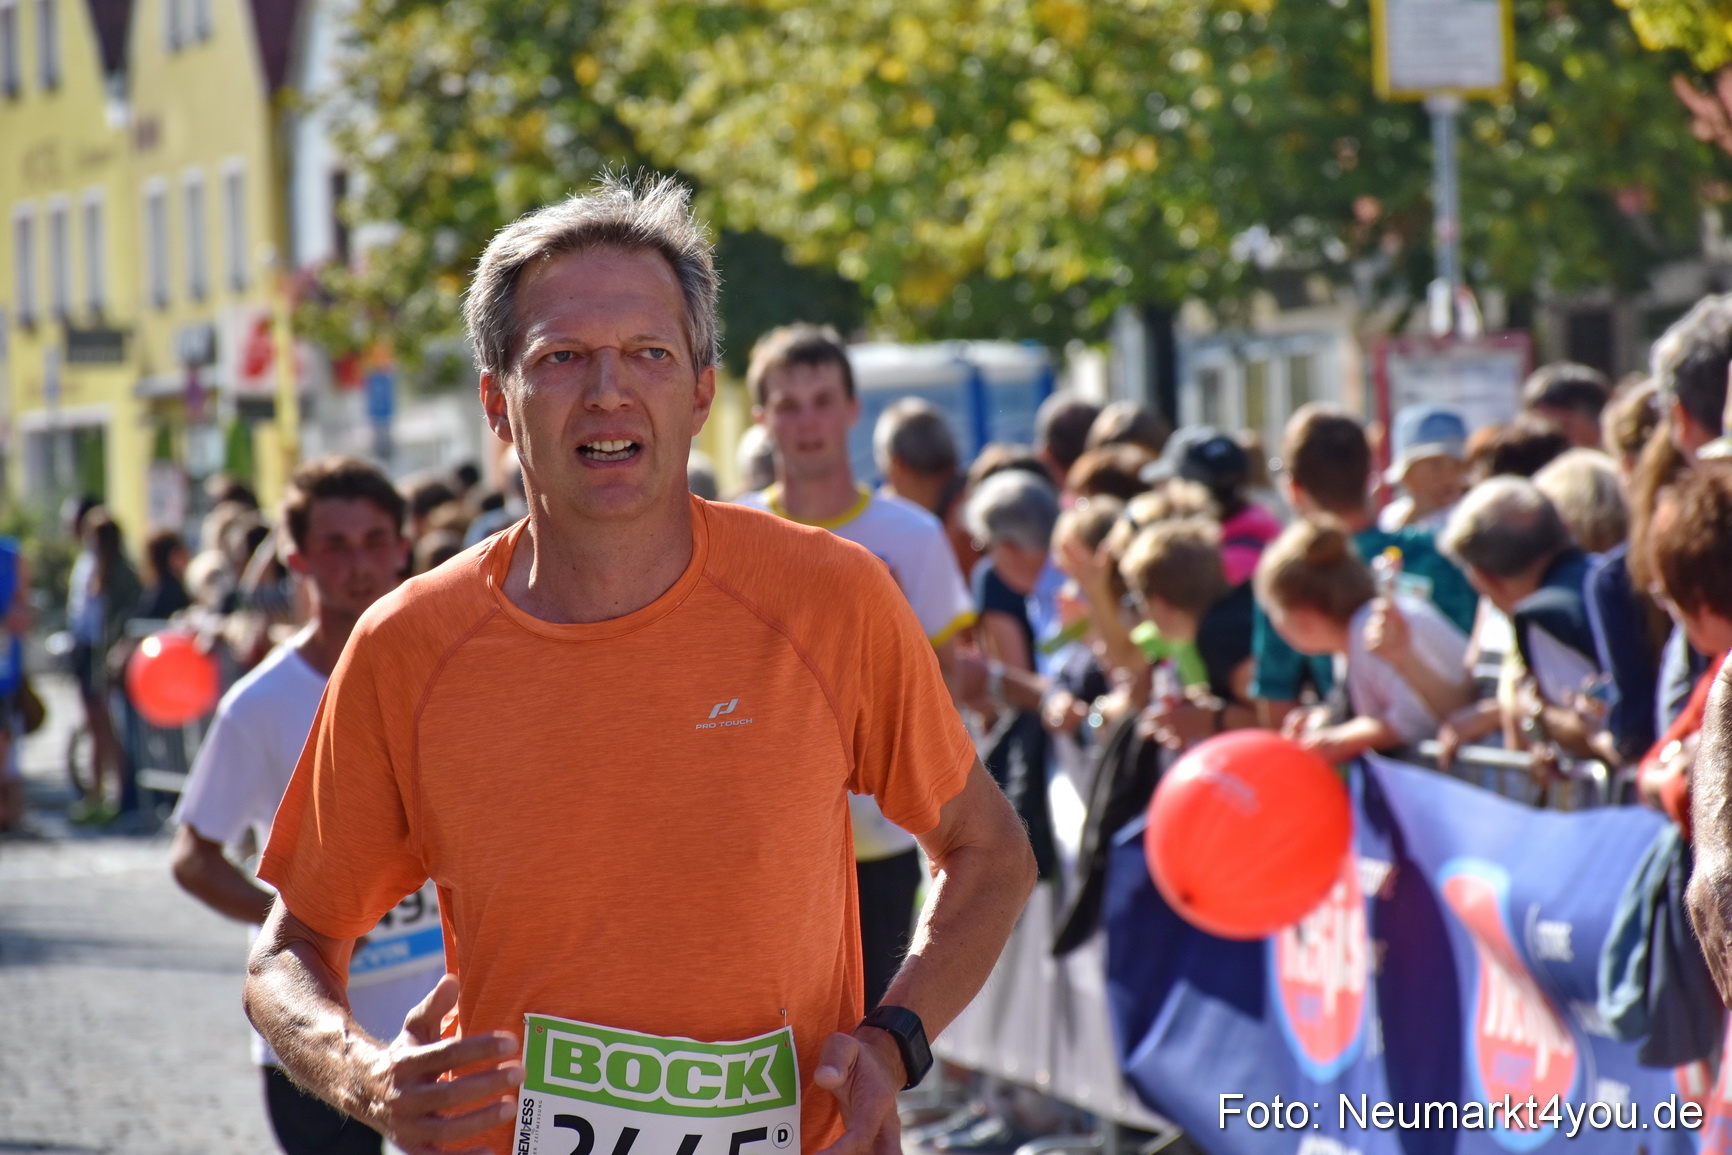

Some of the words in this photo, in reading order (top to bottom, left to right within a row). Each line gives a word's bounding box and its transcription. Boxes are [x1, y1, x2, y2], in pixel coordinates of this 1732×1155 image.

[719, 718, 752, 727] TOUCH
[544, 1029, 781, 1107] BOCK
[534, 1100, 543, 1143] ZEITMESSUNG
[777, 1129, 788, 1143] D
